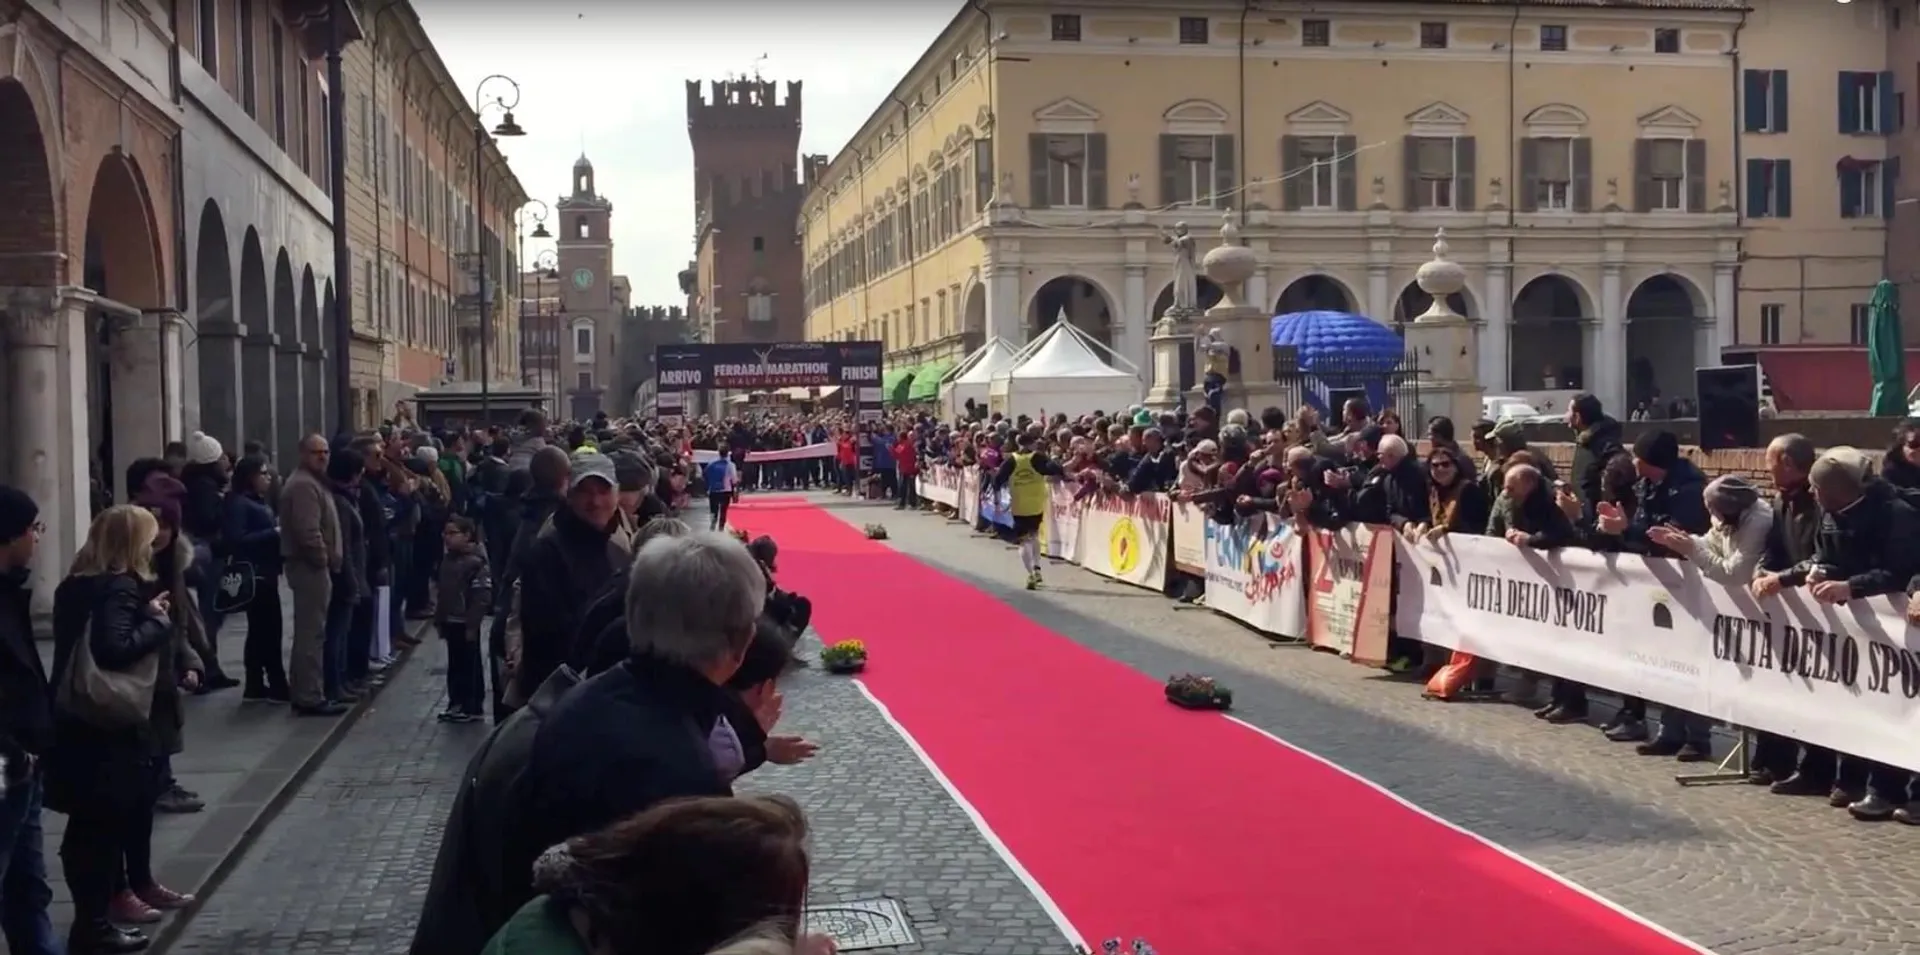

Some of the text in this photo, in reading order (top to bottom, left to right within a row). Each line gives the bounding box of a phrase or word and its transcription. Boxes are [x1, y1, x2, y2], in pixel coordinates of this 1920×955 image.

[714, 362, 828, 376] FERRARA MARATHON
[841, 366, 877, 380] FINISH
[660, 370, 701, 385] ARRIVO
[728, 377, 757, 386] HALF
[765, 375, 829, 385] MARATHON
[1467, 570, 1607, 634] CITTÀ DELLO SPORT
[1713, 612, 1920, 699] CITTÀ DELLO SPO
